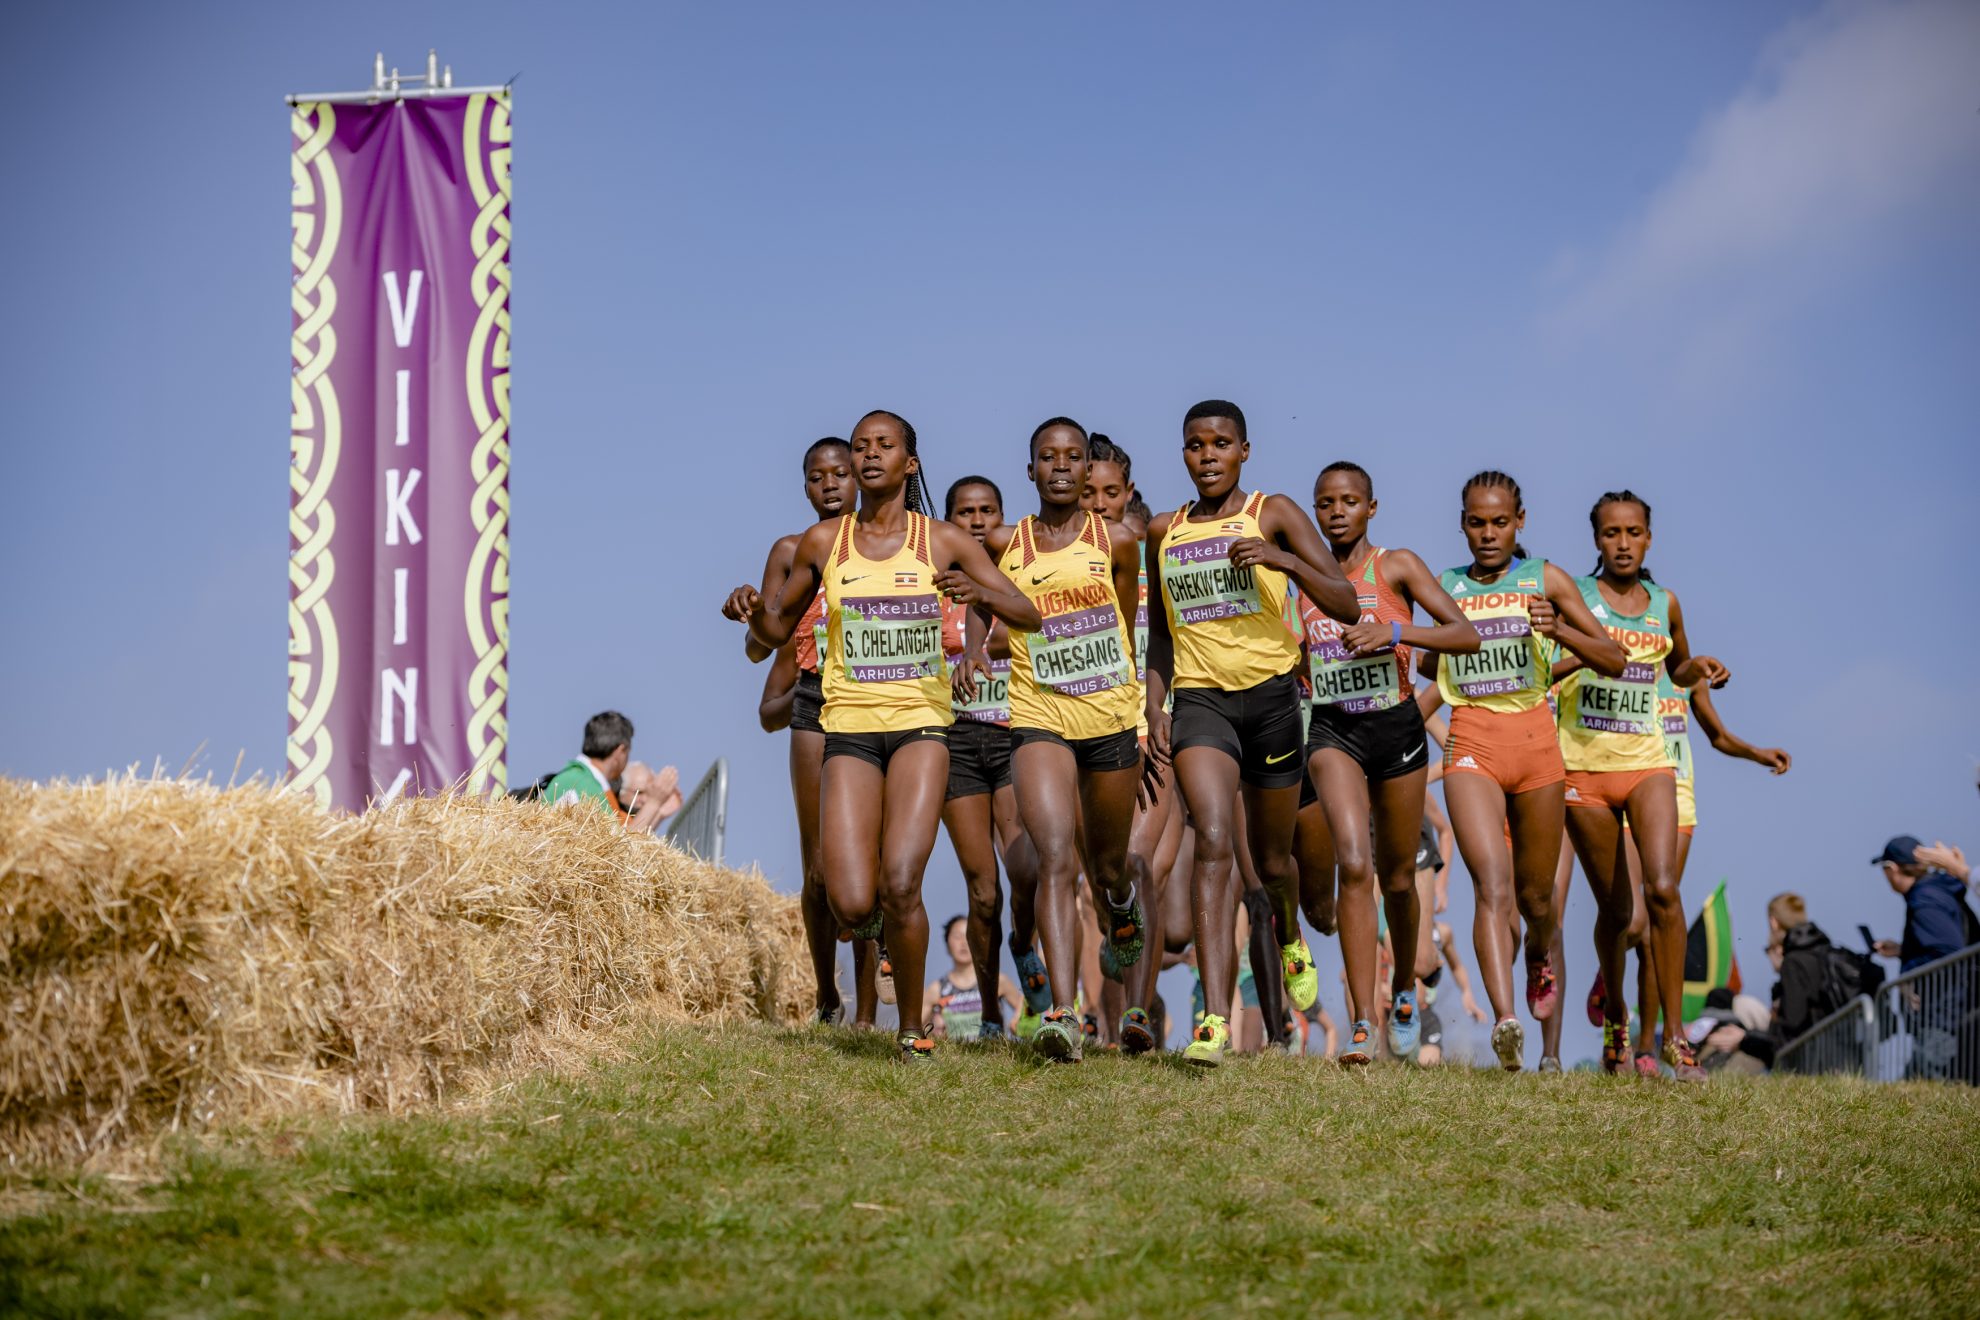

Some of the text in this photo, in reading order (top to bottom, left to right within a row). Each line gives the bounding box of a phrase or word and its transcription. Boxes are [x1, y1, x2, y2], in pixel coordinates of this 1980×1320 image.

[1167, 542, 1228, 564] Mikkell
[1166, 565, 1254, 603] CHEKWEMOI
[844, 602, 938, 616] Mikkeller
[1035, 584, 1108, 617] UGANDA
[1180, 601, 1258, 622] AARHUS 2019
[845, 630, 858, 658] S.
[861, 625, 939, 659] CHELANGAT
[1475, 622, 1529, 636] keller
[1035, 636, 1122, 679] CHESANG
[1451, 643, 1529, 677] TARIKU
[850, 667, 906, 681] AARHUS
[1315, 661, 1391, 698] CHEBET
[1581, 685, 1650, 714] KEFALE
[1580, 717, 1627, 733] AARHUS
